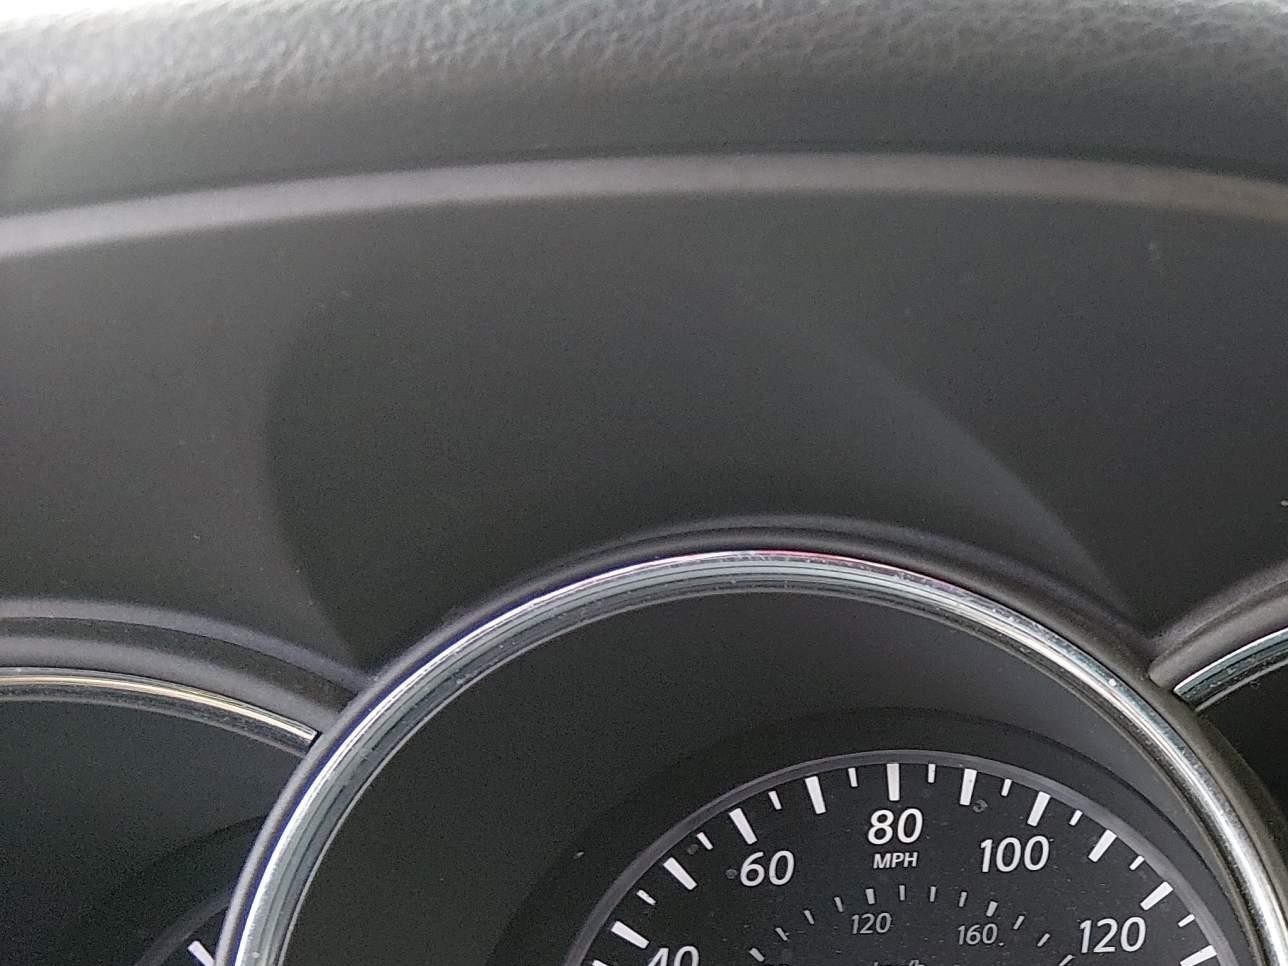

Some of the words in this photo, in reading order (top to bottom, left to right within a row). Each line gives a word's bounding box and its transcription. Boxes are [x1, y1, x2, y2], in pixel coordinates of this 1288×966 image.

[867, 807, 923, 845] 80
[739, 850, 795, 887] 60
[873, 851, 919, 869] MPH
[980, 834, 1050, 873] 100
[851, 912, 892, 935] 120
[958, 922, 999, 945] 160
[1079, 916, 1147, 954] 120
